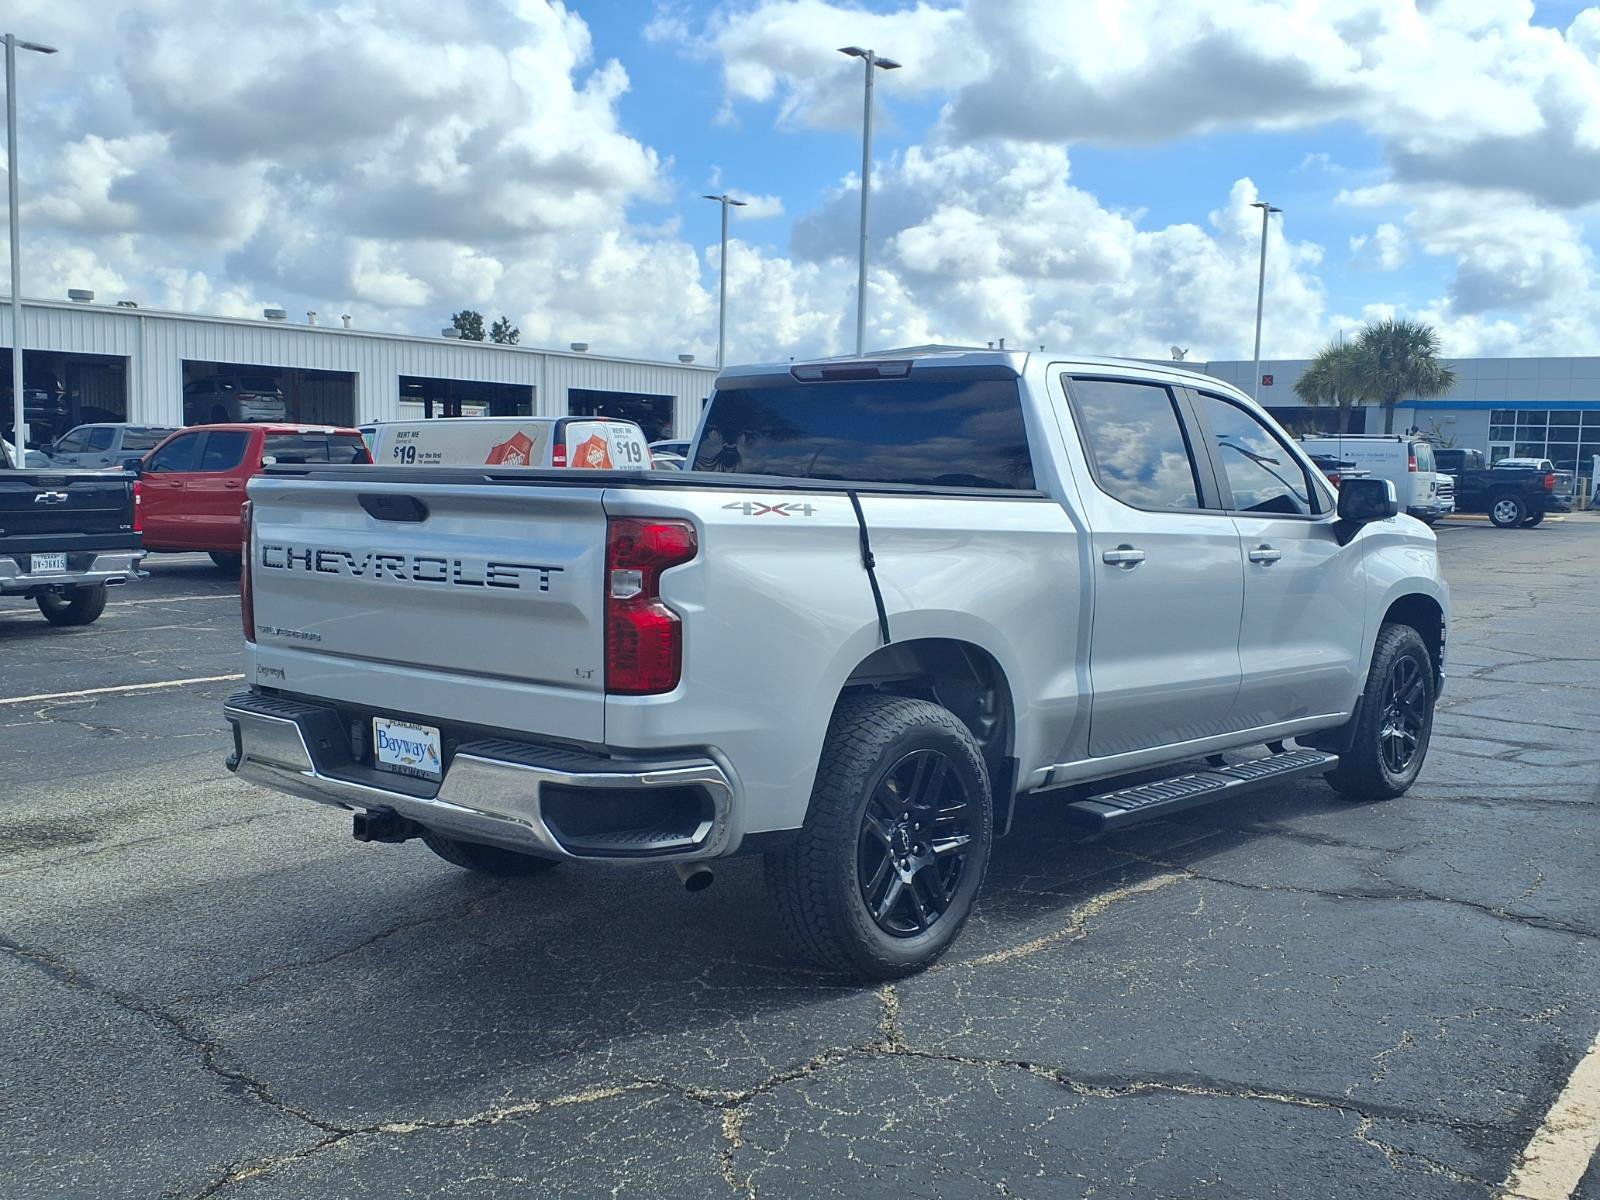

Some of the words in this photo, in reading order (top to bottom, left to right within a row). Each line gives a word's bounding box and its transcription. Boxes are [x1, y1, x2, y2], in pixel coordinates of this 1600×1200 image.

[393, 445, 416, 464] $19
[617, 441, 642, 462] $19
[262, 545, 564, 591] CHEVROLET
[575, 667, 594, 679] LT
[389, 720, 423, 731] PEARLAND
[378, 729, 427, 763] Bayway
